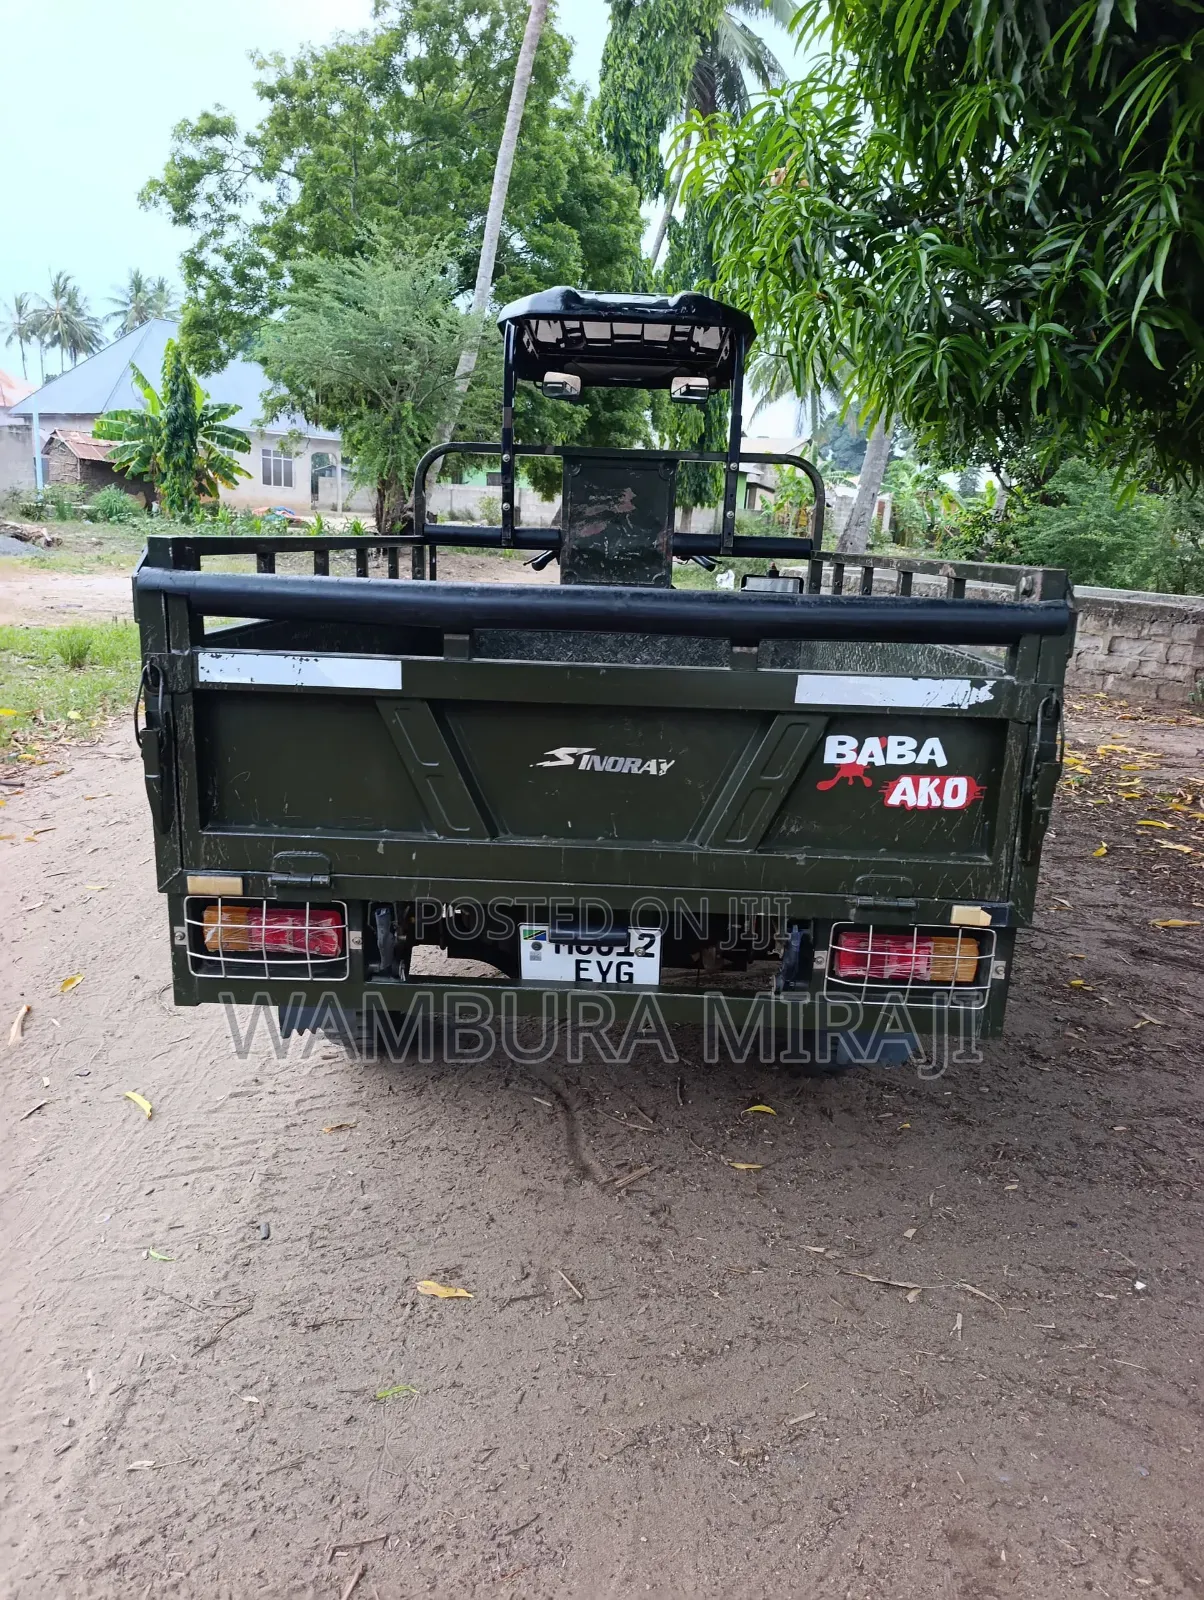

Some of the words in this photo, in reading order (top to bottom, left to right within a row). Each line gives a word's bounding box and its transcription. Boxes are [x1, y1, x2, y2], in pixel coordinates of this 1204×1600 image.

[529, 746, 677, 777] SINORAY
[823, 735, 949, 767] BABA
[887, 776, 970, 808] AKO
[575, 959, 634, 984] EYG
